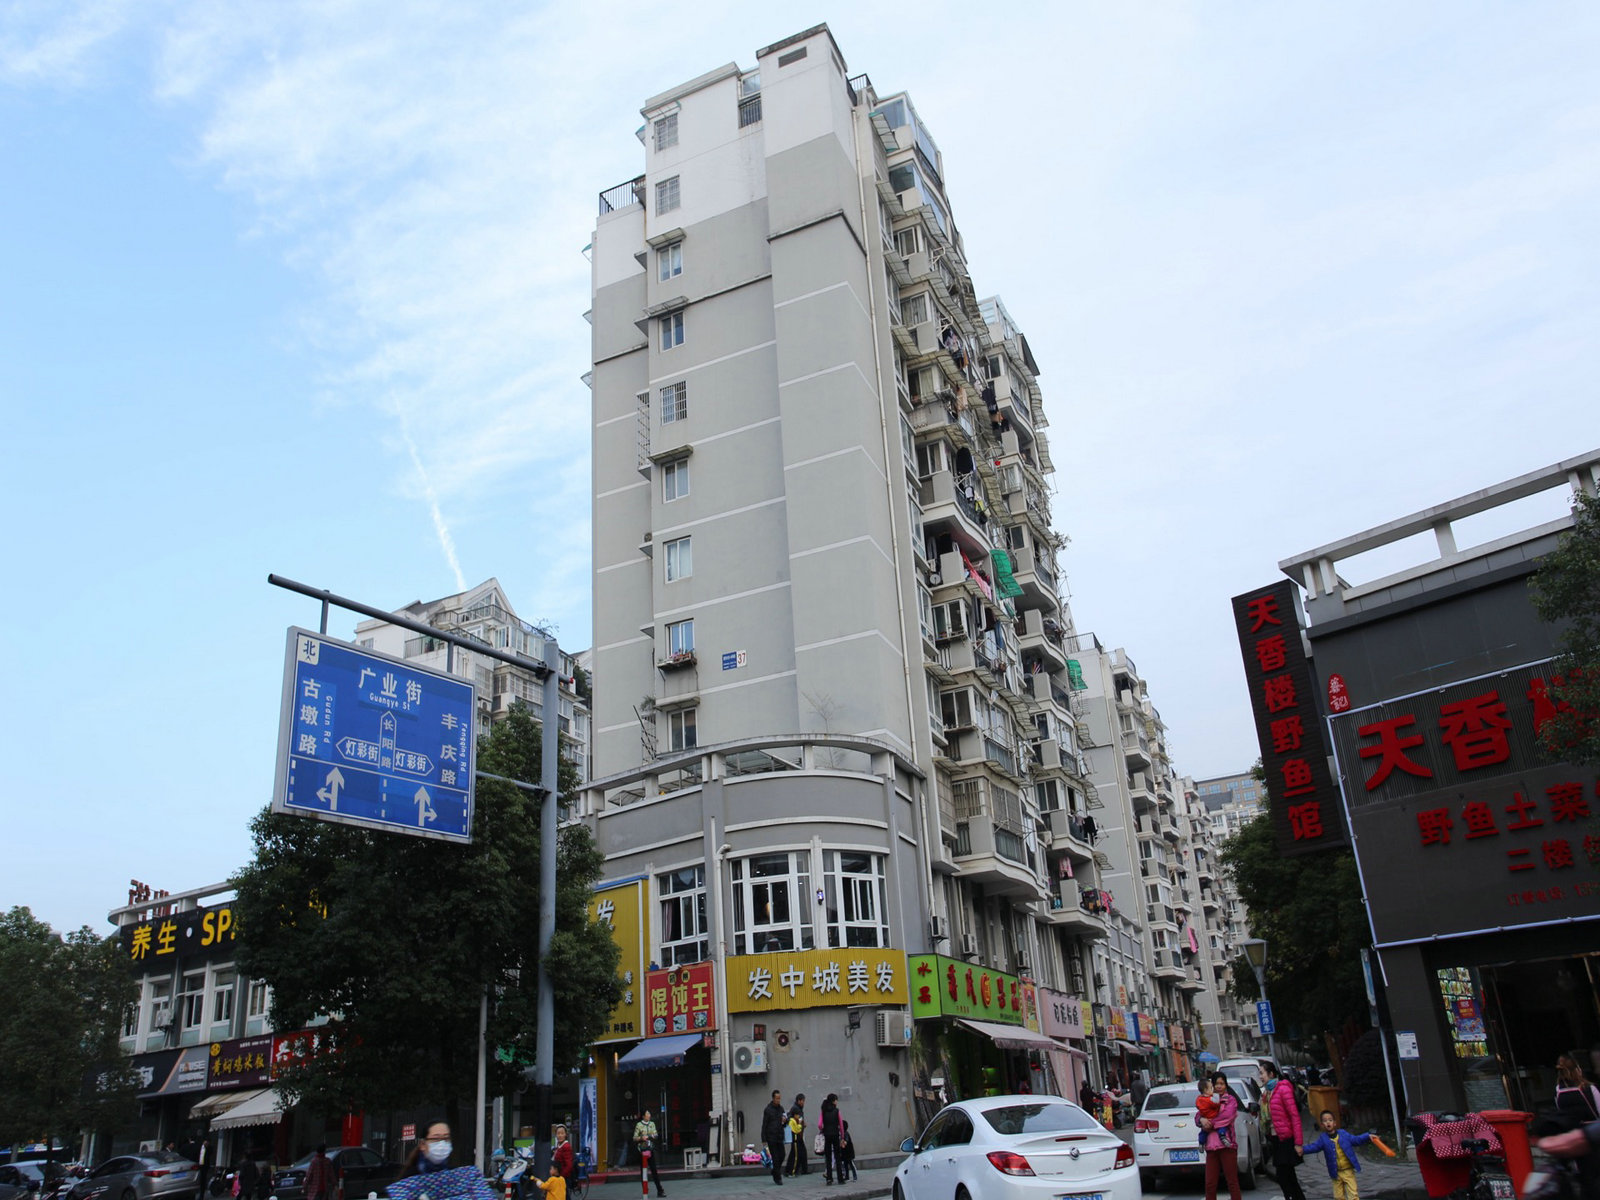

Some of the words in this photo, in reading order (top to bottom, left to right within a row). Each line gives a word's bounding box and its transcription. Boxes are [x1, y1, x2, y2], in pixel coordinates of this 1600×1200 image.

[303, 639, 317, 656] 北
[737, 652, 746, 665] 37
[358, 667, 422, 705] 广业街
[298, 678, 321, 756] 古墩路
[402, 701, 411, 711] St
[1246, 594, 1324, 841] 天香楼野鱼馆
[323, 729, 332, 745] Rd
[440, 713, 459, 786] 丰庆路
[345, 740, 379, 761] 灯彩街
[395, 751, 427, 772] 灯彩街
[460, 760, 467, 773] Rd
[131, 919, 178, 960] 养生
[747, 961, 895, 1000] 发中城美发
[651, 982, 710, 1018] 馄饨王
[1259, 1003, 1271, 1032] 禁止停车
[212, 1053, 265, 1076] 黄焖鸡米饭
